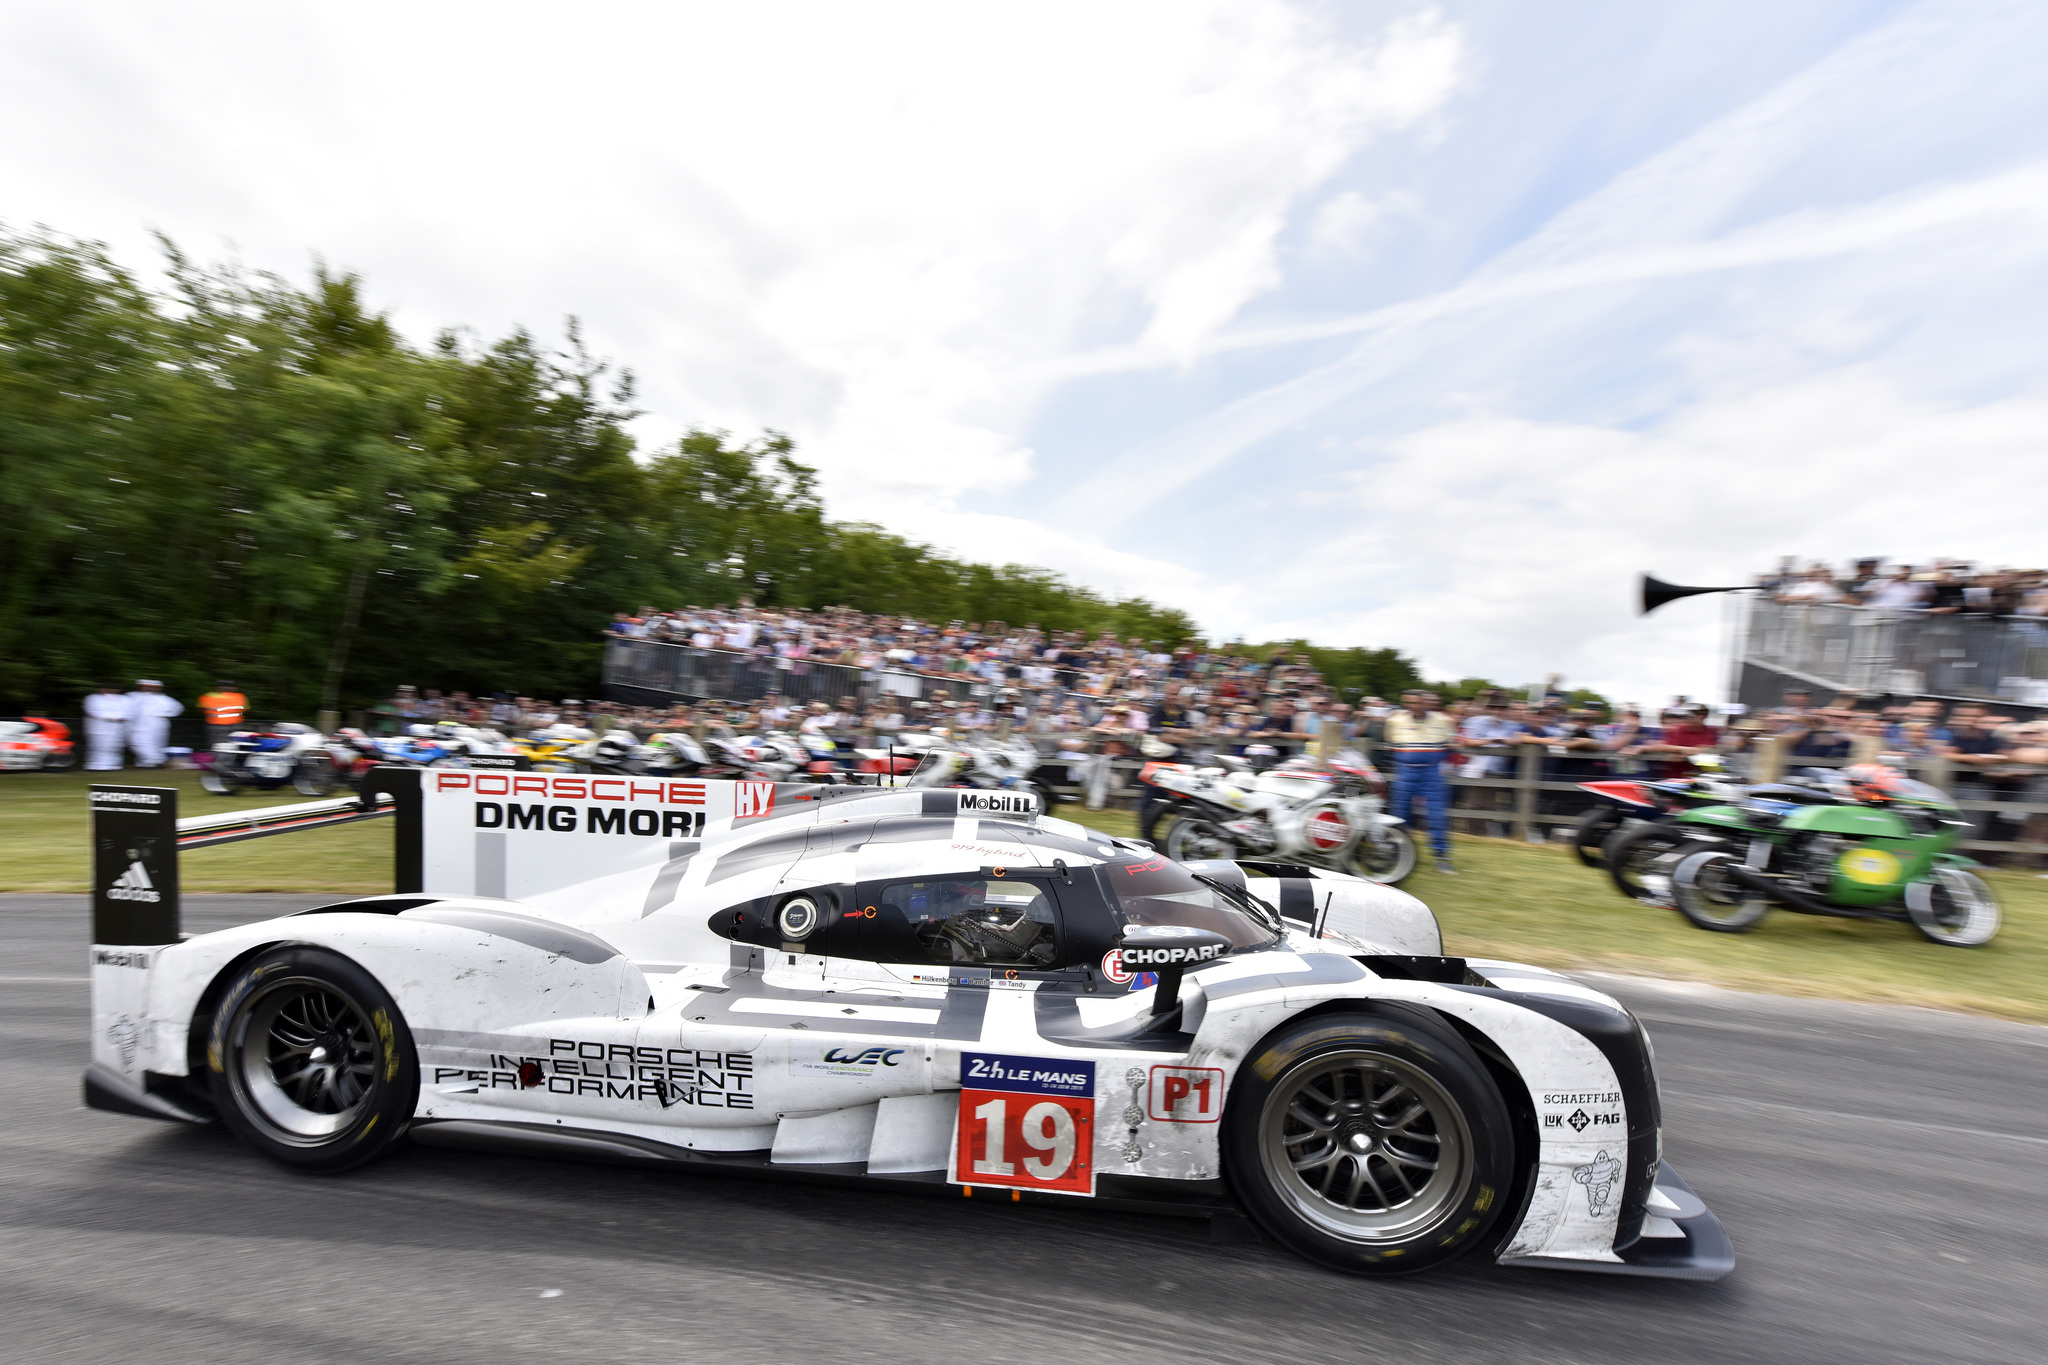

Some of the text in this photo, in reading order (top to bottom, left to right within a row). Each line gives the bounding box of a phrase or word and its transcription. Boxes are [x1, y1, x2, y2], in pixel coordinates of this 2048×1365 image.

[437, 773, 706, 805] PORSCHE
[735, 781, 774, 818] HY
[961, 794, 1011, 812] Mobil
[475, 801, 707, 838] DMG MORI
[951, 843, 975, 851] 919
[106, 888, 161, 903] adidas
[1008, 981, 1027, 989] Tandy
[550, 1038, 753, 1072] PORSCHE
[823, 1047, 905, 1067] WEC
[490, 1053, 753, 1091] INTELLIGENT
[1007, 1069, 1032, 1081] LE
[1032, 1070, 1088, 1086] MANS
[1163, 1076, 1211, 1114] P1
[1543, 1092, 1621, 1104] SCHAEFFLER
[1593, 1112, 1620, 1126] FAG
[973, 1098, 1077, 1181] 19
